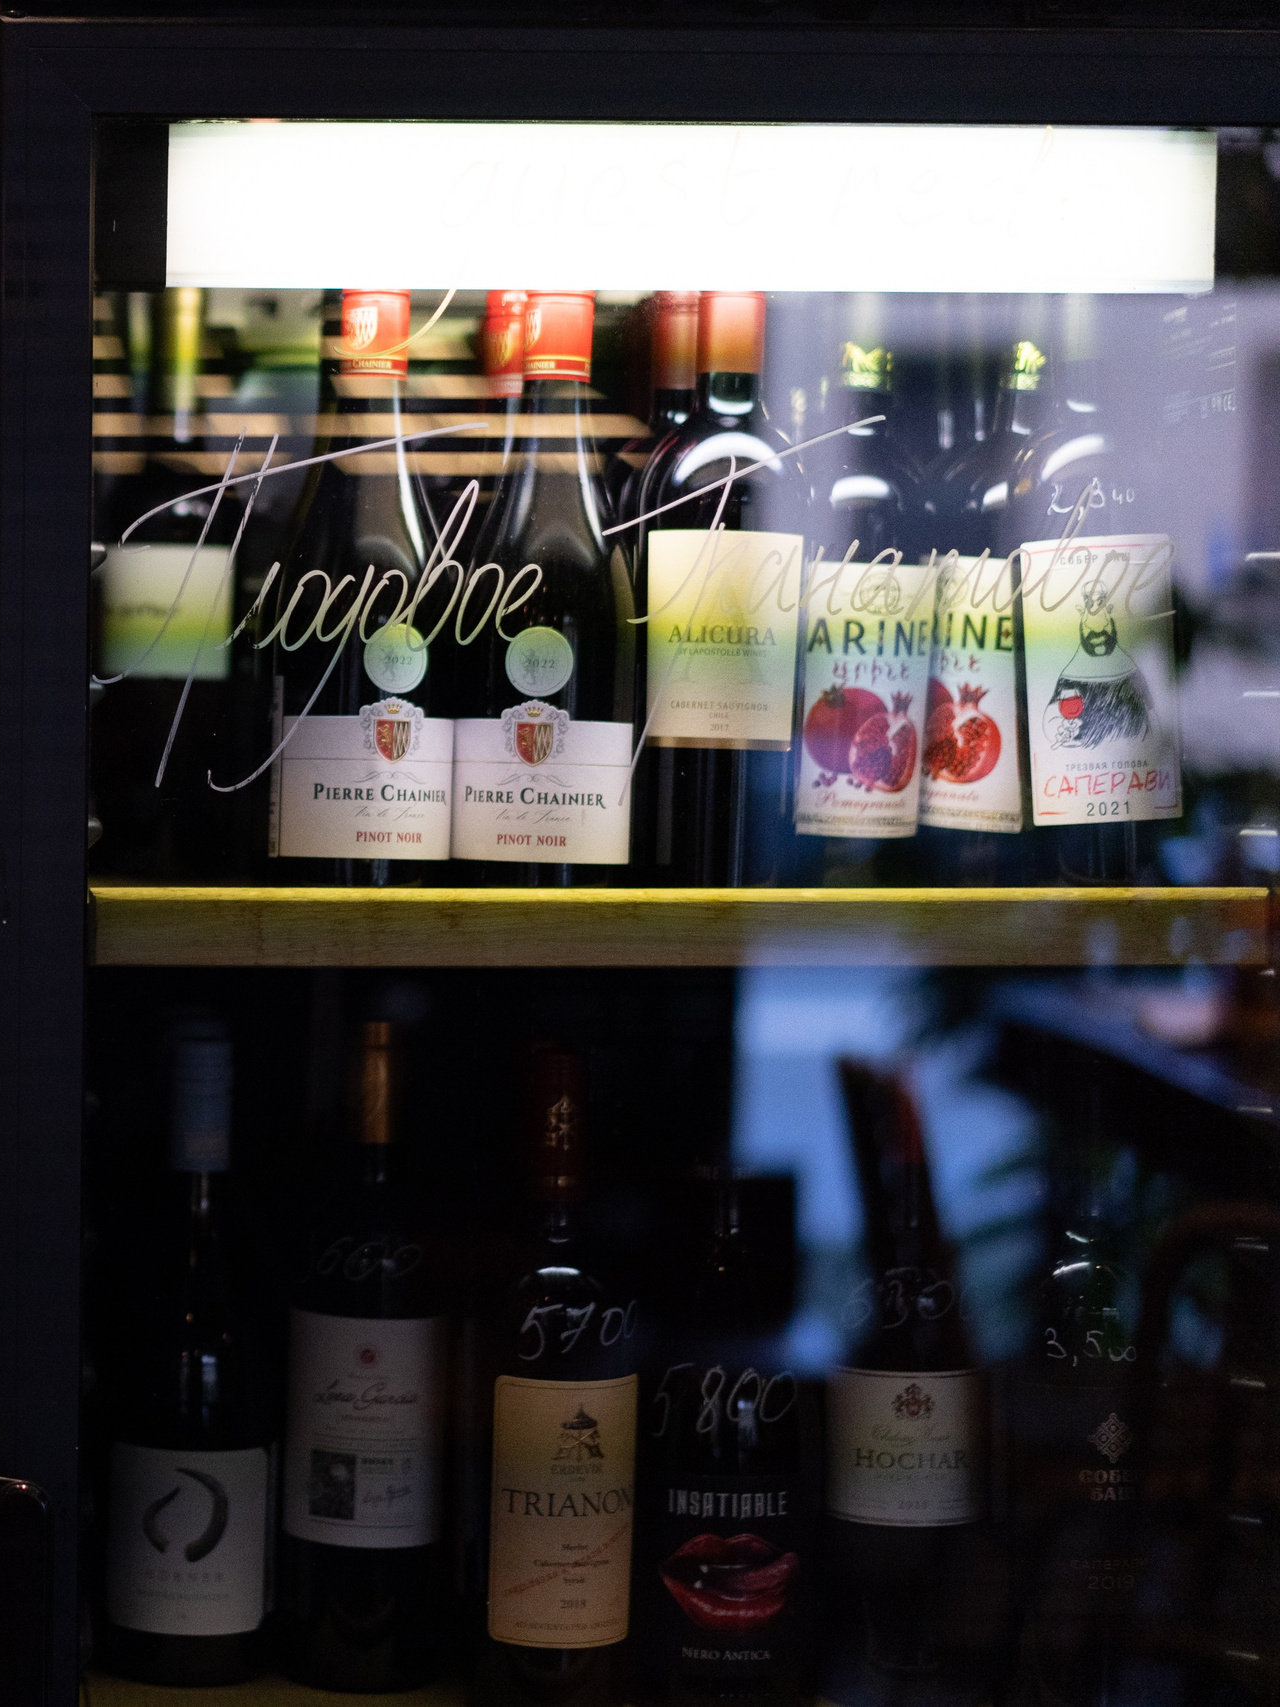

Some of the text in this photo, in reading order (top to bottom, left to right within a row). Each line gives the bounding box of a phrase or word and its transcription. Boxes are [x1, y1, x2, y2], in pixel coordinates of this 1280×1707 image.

[92, 423, 542, 793] Плодовое
[603, 415, 1177, 806] Гранатовое
[667, 624, 777, 646] ALICURA
[313, 782, 447, 805] PIERRE CHAINIER
[1043, 770, 1172, 798] САПЕРАВИ
[464, 785, 606, 809] PIERRE CHAINIER
[1086, 801, 1130, 817] 2021
[355, 831, 422, 844] PINOT NOIR
[496, 833, 567, 847] PINOT NOIR
[651, 1361, 798, 1438] 5800
[667, 1488, 789, 1519] INSATIABLE
